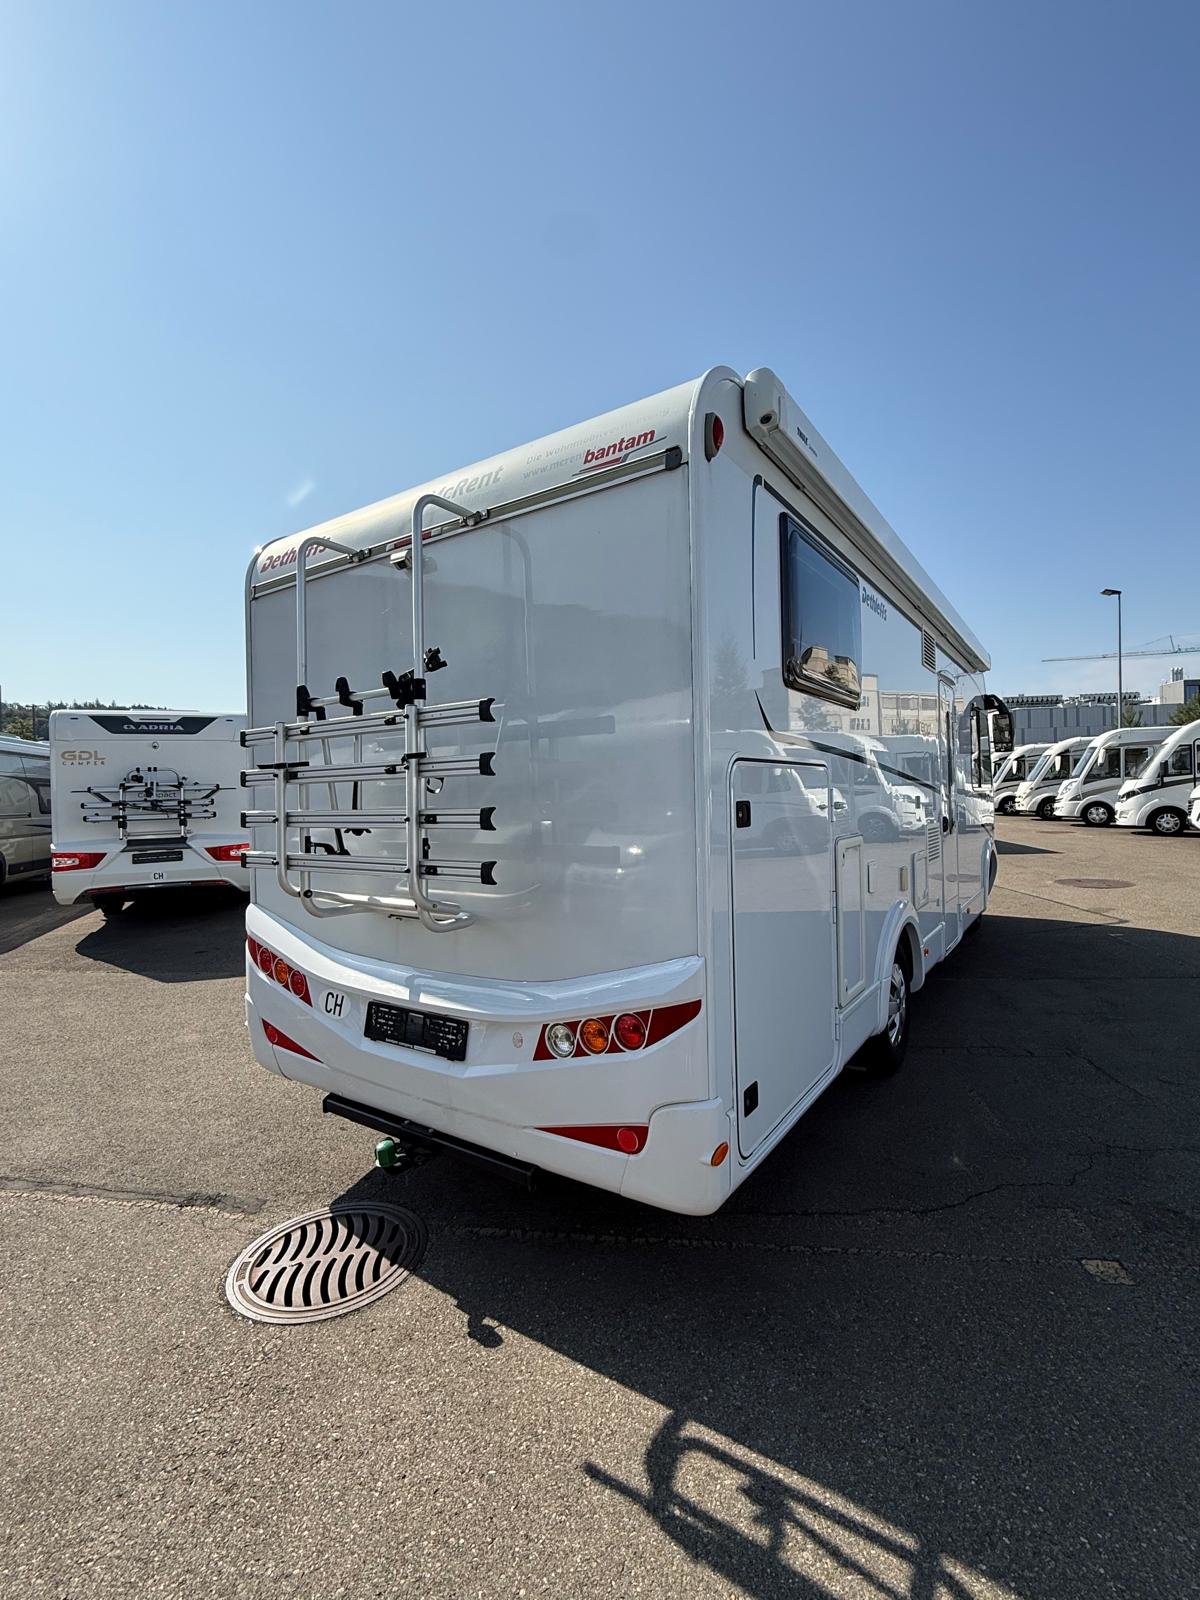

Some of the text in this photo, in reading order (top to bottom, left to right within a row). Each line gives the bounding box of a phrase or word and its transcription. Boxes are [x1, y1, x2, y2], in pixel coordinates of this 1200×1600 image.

[583, 429, 656, 465] bantam
[862, 586, 888, 621] Dethleffs
[61, 750, 106, 760] GDL
[153, 872, 164, 880] CH
[325, 991, 344, 1017] CH
